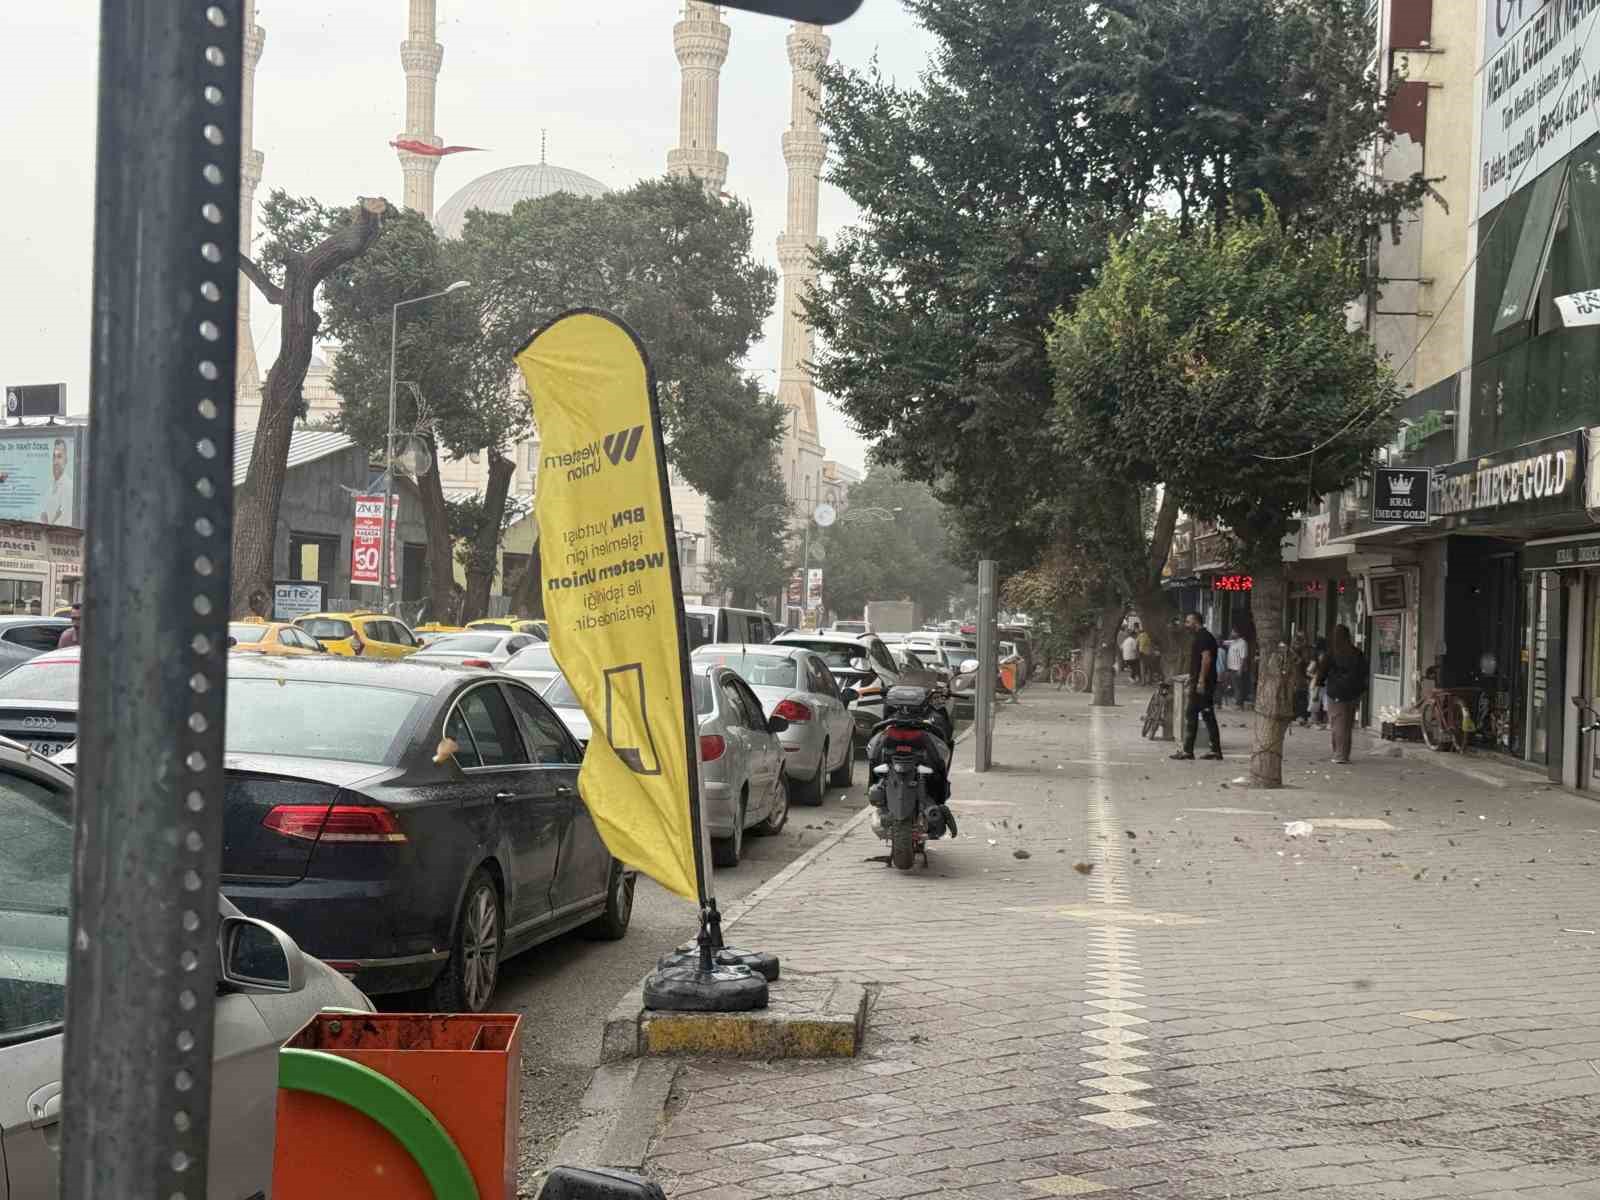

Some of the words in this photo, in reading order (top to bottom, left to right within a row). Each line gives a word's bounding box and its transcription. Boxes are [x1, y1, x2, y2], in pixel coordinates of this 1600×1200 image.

[1522, 451, 1567, 500] GOLD
[1389, 497, 1412, 507] KRAL
[1403, 509, 1426, 520] GOLD
